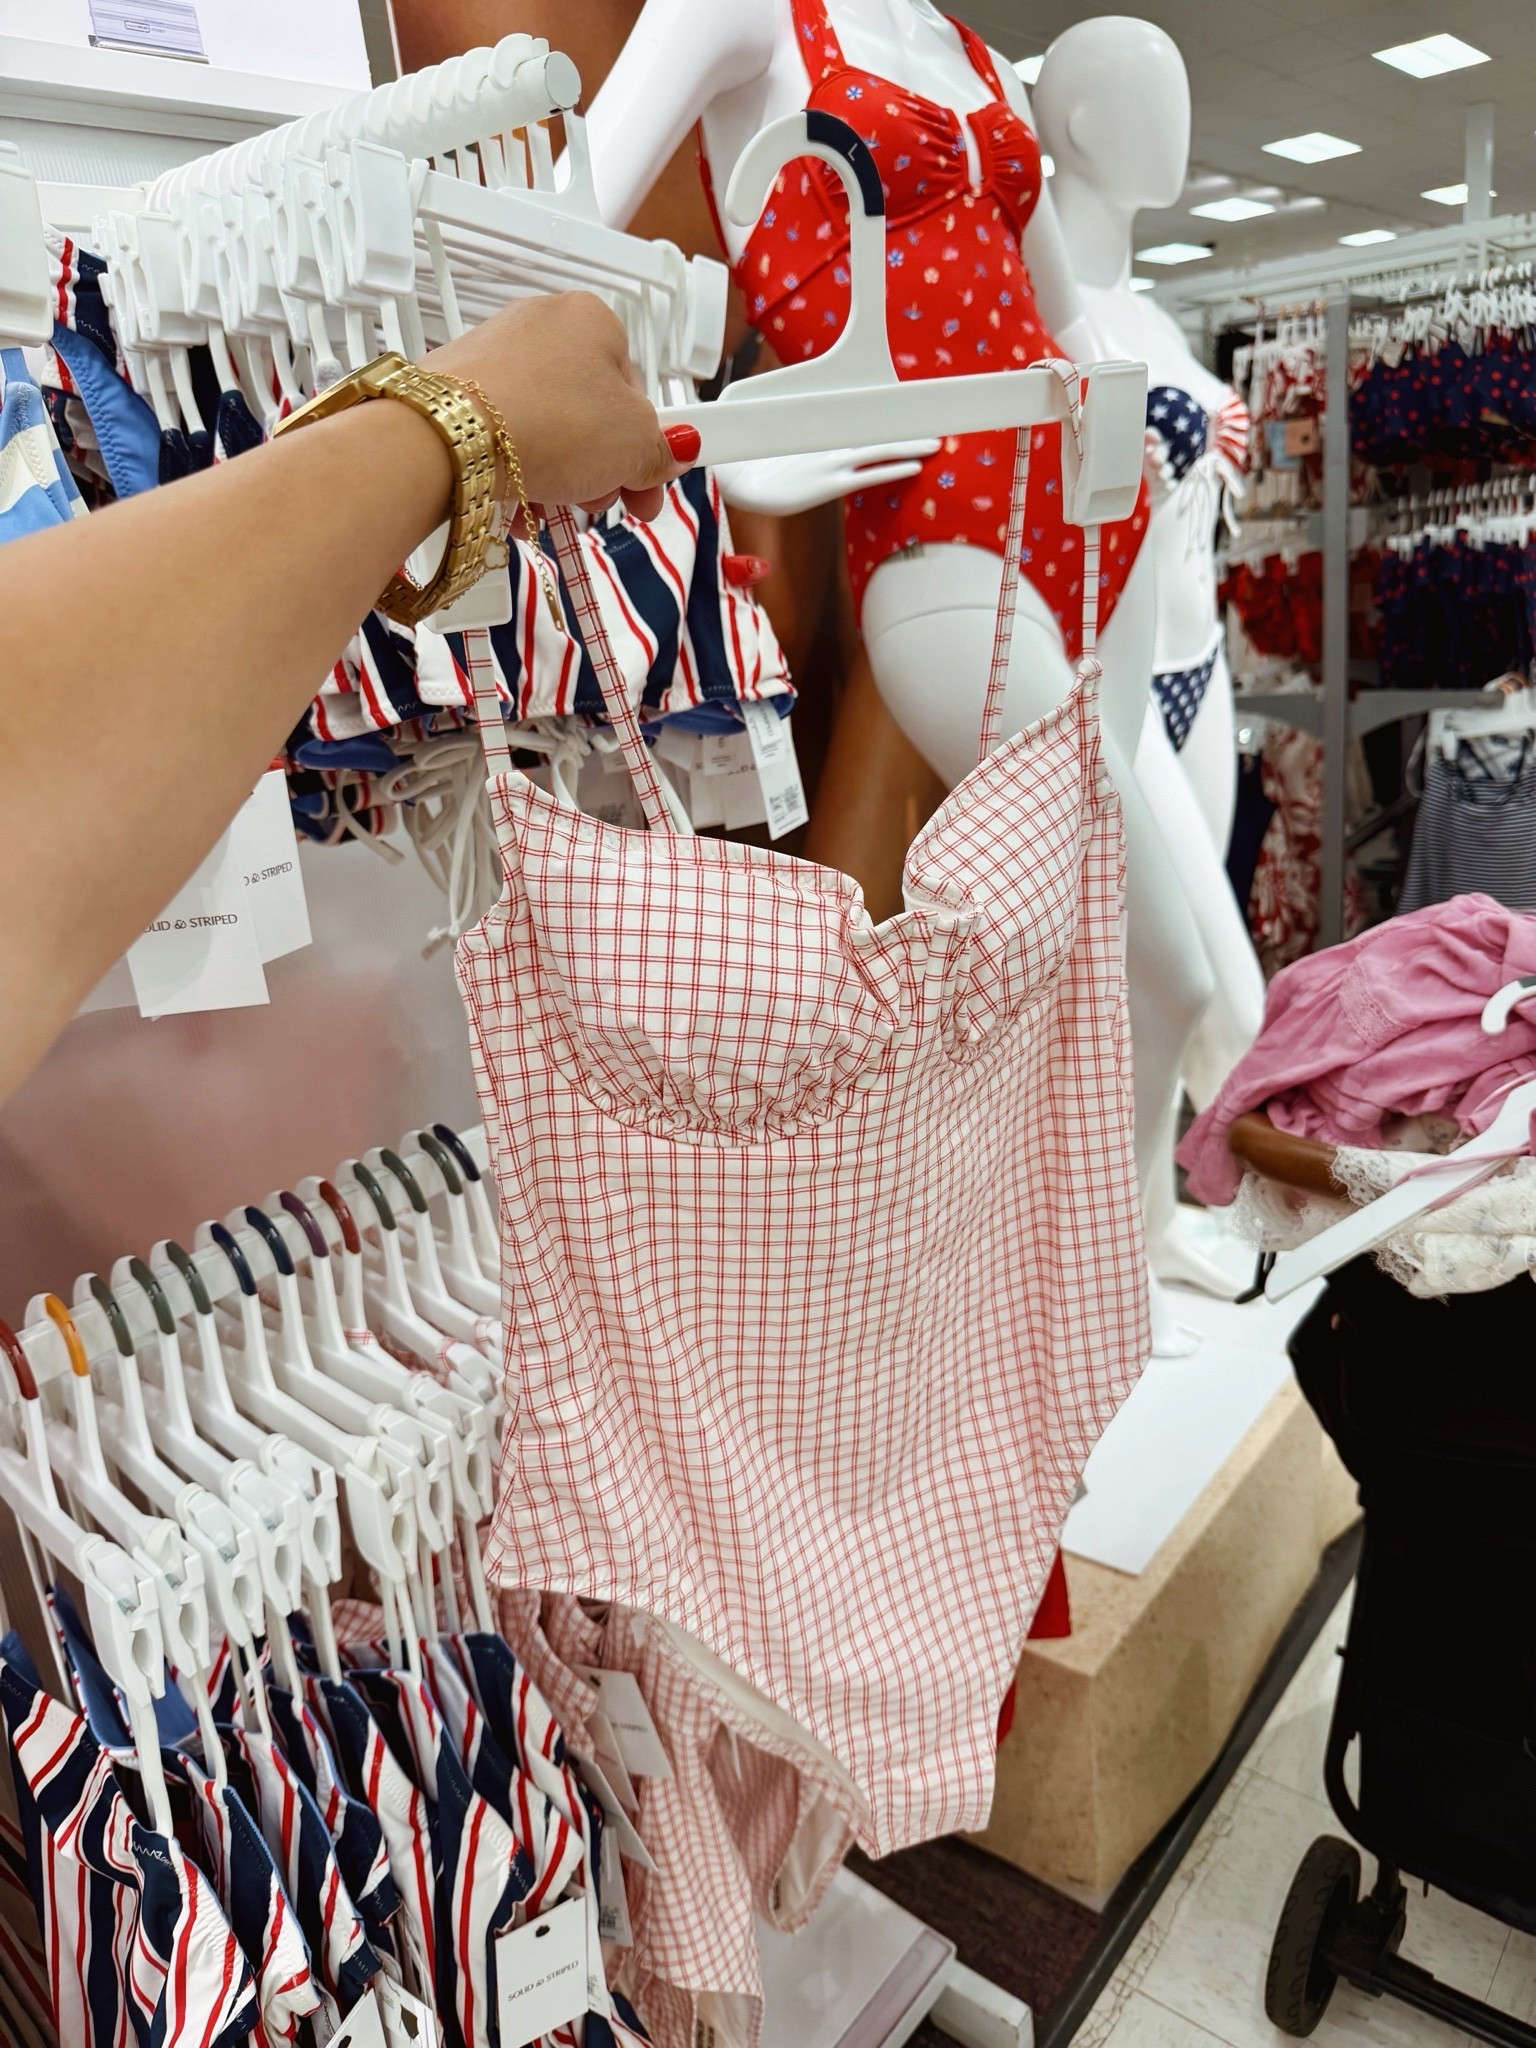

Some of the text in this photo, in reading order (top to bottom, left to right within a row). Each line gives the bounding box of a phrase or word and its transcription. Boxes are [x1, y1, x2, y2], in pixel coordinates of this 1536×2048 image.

[261, 861, 293, 880] STRIPED
[174, 919, 187, 930] &
[189, 914, 238, 928] STRIPED
[507, 1983, 534, 2002] SOLID
[546, 1960, 579, 1982] STRIPED
